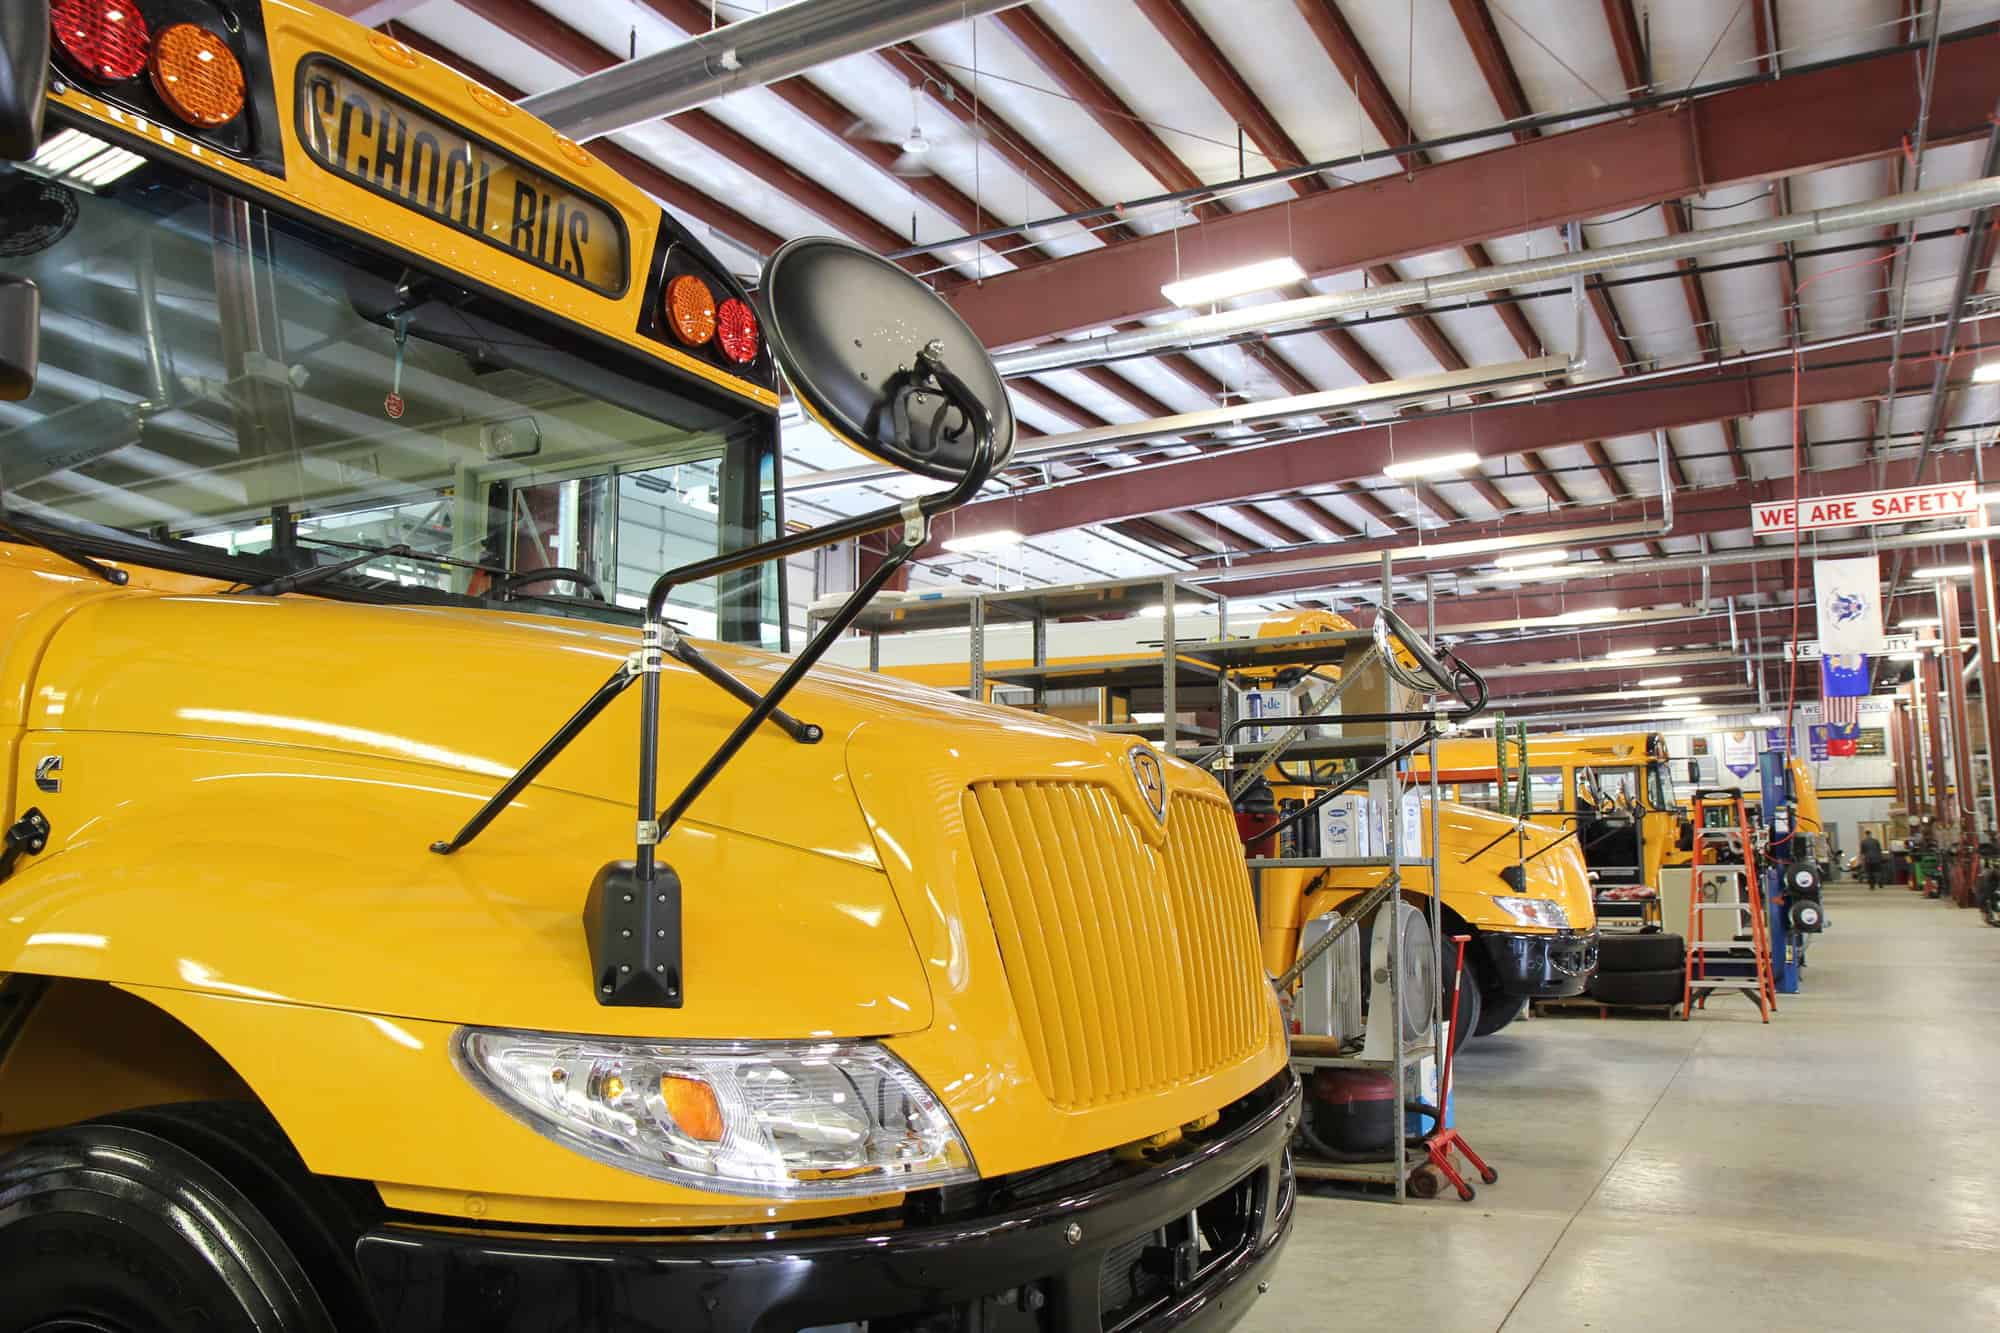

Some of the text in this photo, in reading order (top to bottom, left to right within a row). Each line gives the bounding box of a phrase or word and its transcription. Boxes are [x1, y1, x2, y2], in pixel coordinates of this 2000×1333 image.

[511, 180, 588, 279] BUS
[1759, 489, 1968, 527] WE ARE SAFETY
